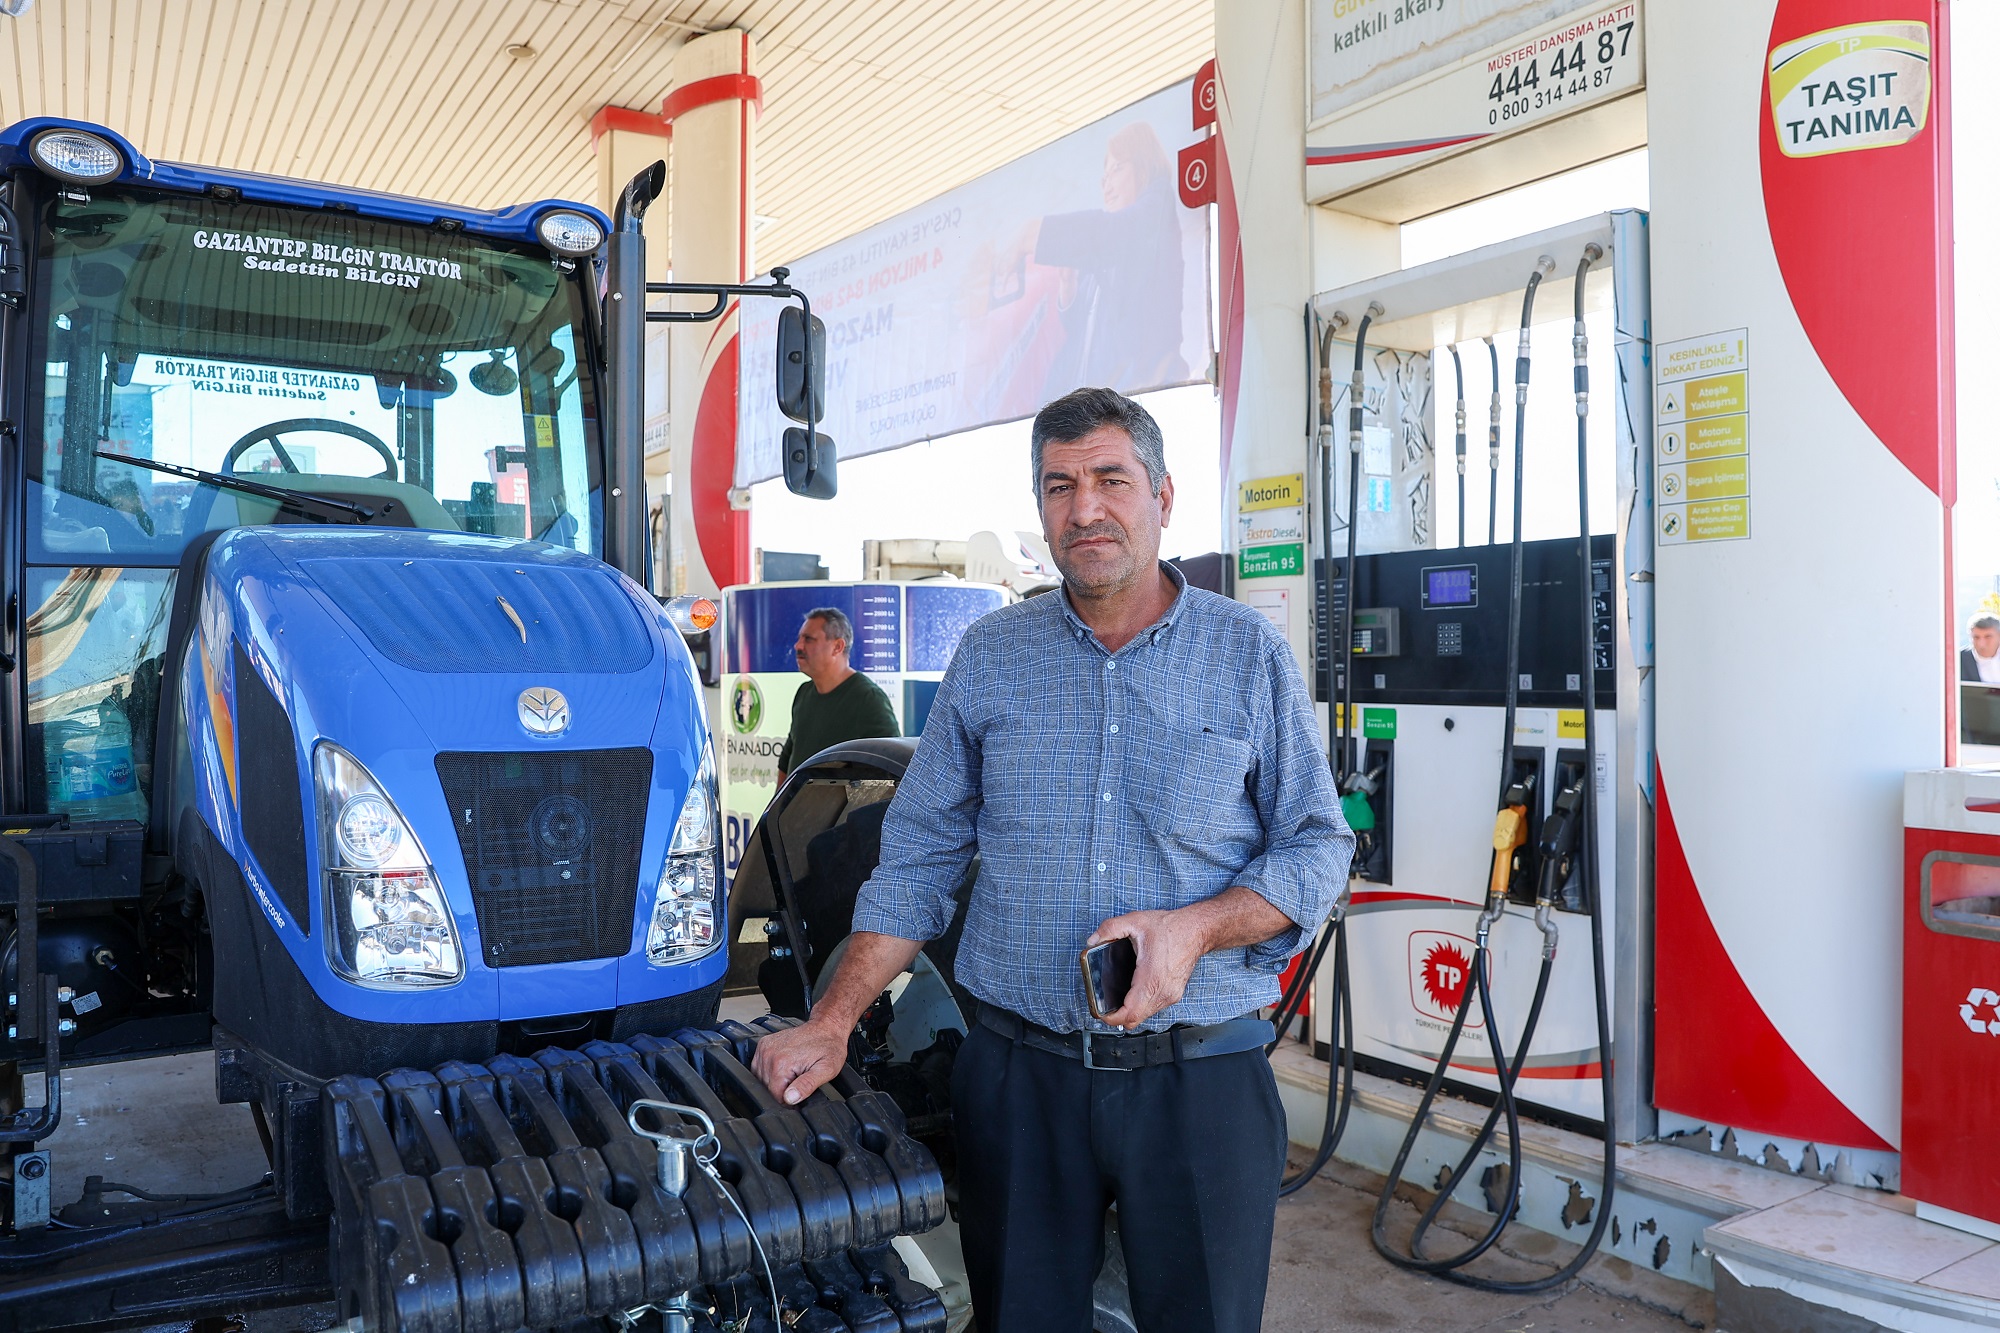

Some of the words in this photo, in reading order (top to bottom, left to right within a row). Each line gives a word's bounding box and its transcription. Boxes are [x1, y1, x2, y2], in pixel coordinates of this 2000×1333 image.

[1334, 12, 1387, 53] katkılı
[1488, 41, 1537, 73] MÜŞTERİ
[1540, 21, 1594, 52] DANIŞMA
[1598, 4, 1634, 29] HATTI
[1835, 37, 1862, 54] TP
[1488, 58, 1540, 103] 444
[1550, 41, 1586, 80] 44
[1597, 21, 1634, 64] 87
[1206, 86, 1215, 103] 3
[1489, 109, 1497, 125] 0
[1502, 97, 1529, 121] 800
[1535, 84, 1563, 109] 314
[1568, 75, 1588, 96] 44
[1593, 66, 1613, 88] 87
[1801, 72, 1898, 107] TAŞIT
[1786, 105, 1916, 144] TANIMA
[1191, 166, 1201, 183] 4
[243, 255, 340, 278] Sadettin
[379, 252, 462, 279] TRAKTÖR
[1669, 342, 1727, 362] KESİNLİKLE
[1662, 361, 1697, 377] DİKKAT
[1700, 355, 1735, 369] EDİNİZ
[1698, 385, 1729, 397] Ateşle
[1690, 397, 1737, 411] Yaklaşma
[1698, 427, 1731, 437] Motoru
[1689, 437, 1742, 451] Durdurunuz
[1245, 484, 1290, 504] Motorin
[1243, 559, 1278, 573] Benzin
[1281, 556, 1296, 569] 95
[1563, 720, 1585, 728] Motori
[247, 865, 260, 892] turbo
[258, 884, 286, 929] intercooler
[1435, 963, 1462, 991] TP
[1442, 1025, 1484, 1041] PEOLLERİ
